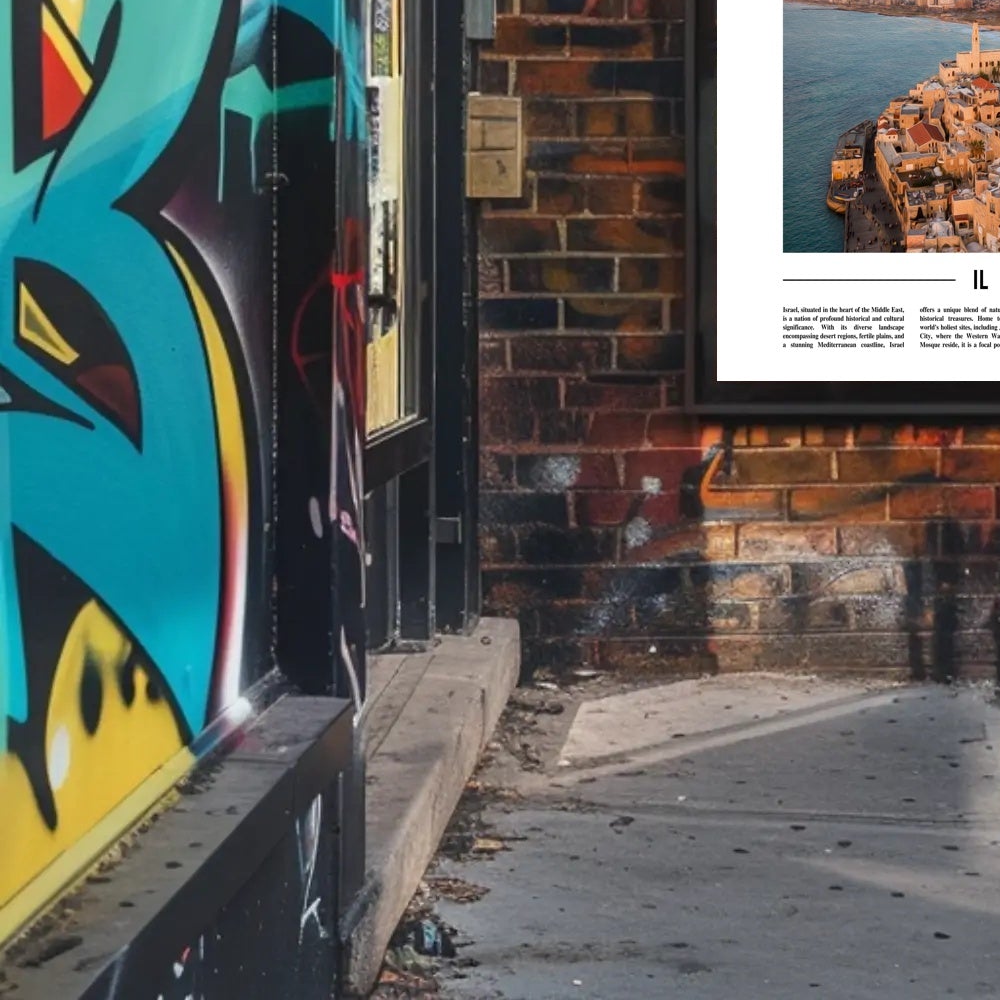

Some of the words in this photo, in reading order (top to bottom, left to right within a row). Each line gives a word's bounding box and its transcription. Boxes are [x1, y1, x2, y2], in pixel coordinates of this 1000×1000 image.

[973, 269, 989, 290] IL
[943, 306, 962, 315] unique
[819, 315, 845, 323] profound
[782, 324, 815, 332] significance.
[878, 324, 905, 332] landscape
[973, 324, 998, 332] including
[782, 332, 819, 341] encompassing
[837, 332, 858, 340] regions,
[875, 332, 894, 341] plains,
[919, 333, 933, 341] City,
[790, 341, 814, 349] stunning
[919, 341, 941, 350] Mosque
